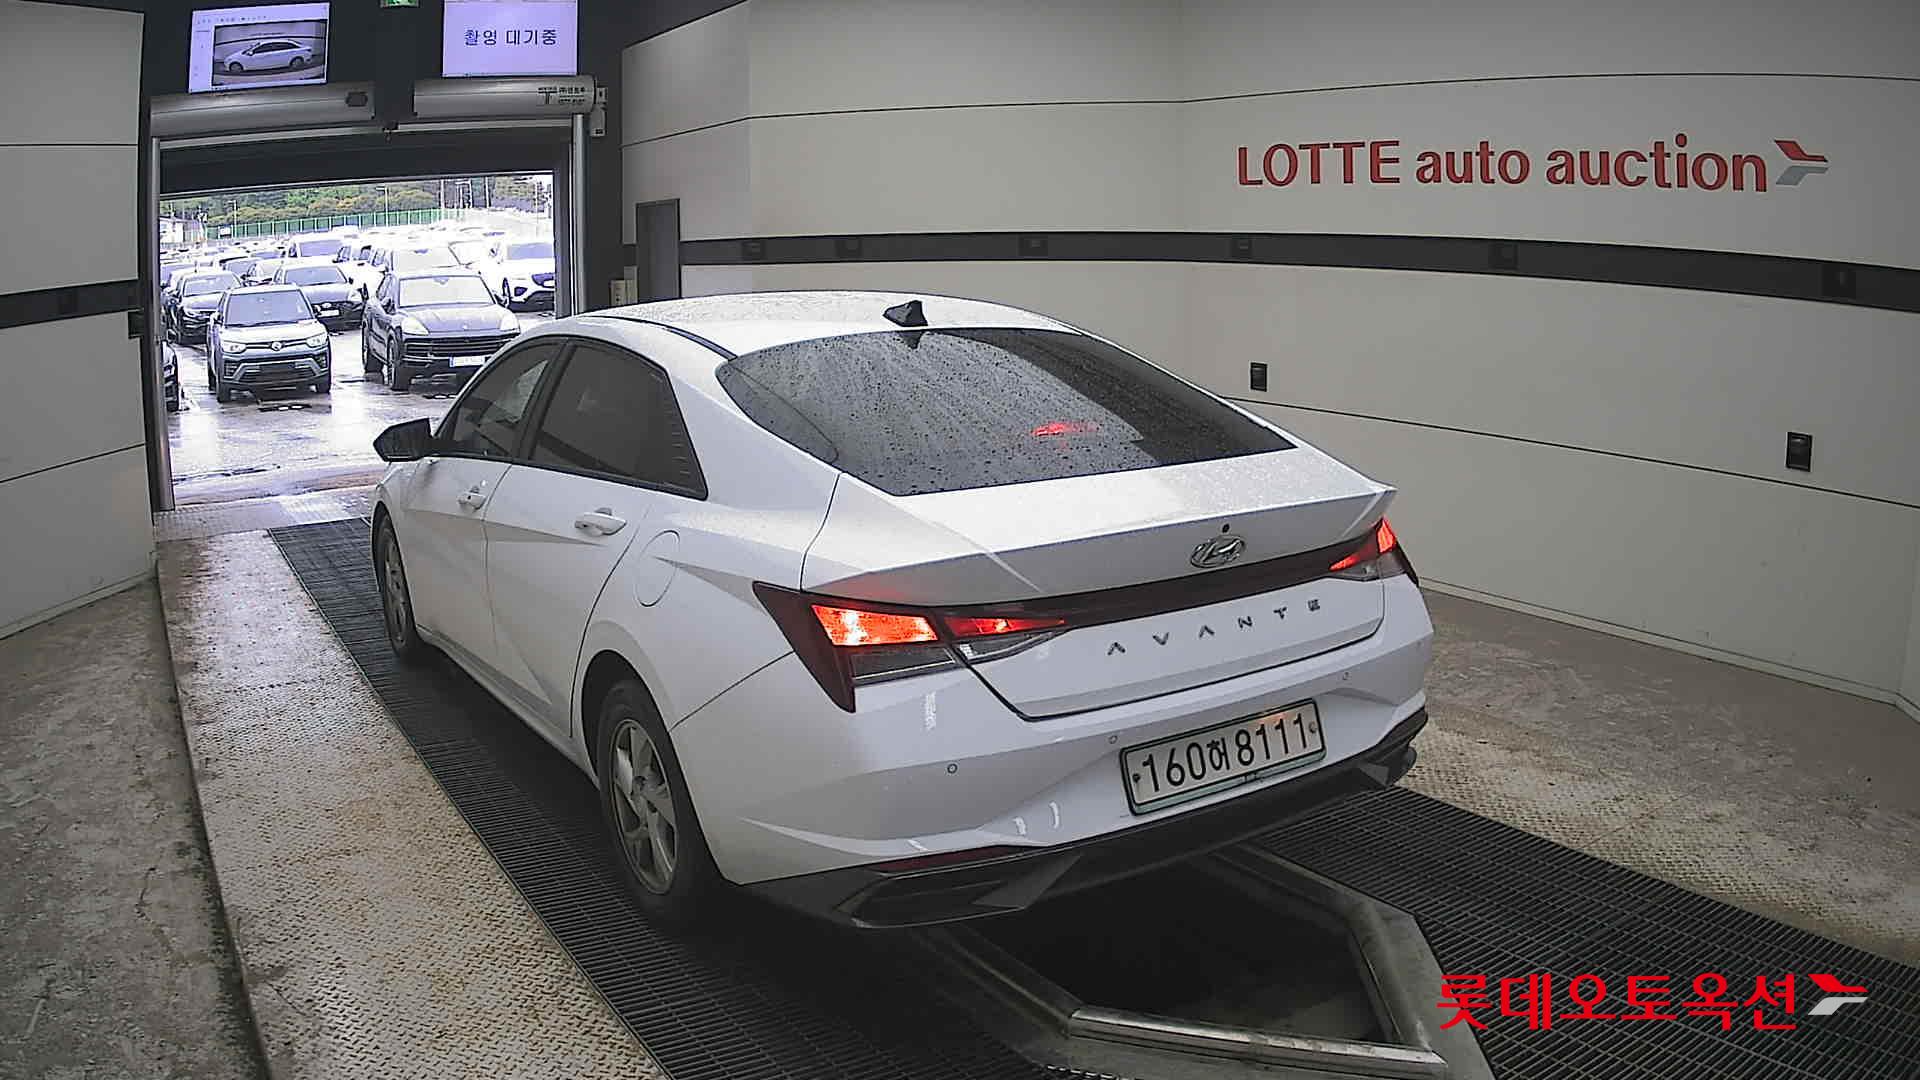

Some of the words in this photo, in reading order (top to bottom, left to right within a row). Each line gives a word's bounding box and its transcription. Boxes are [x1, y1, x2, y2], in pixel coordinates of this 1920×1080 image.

[465, 29, 498, 46] 촬영
[505, 29, 557, 46] 대기중
[1237, 139, 1400, 187] LOTTE
[1415, 140, 1531, 186] auto
[1546, 134, 1767, 192] auction
[1107, 599, 1321, 656] AVANTE
